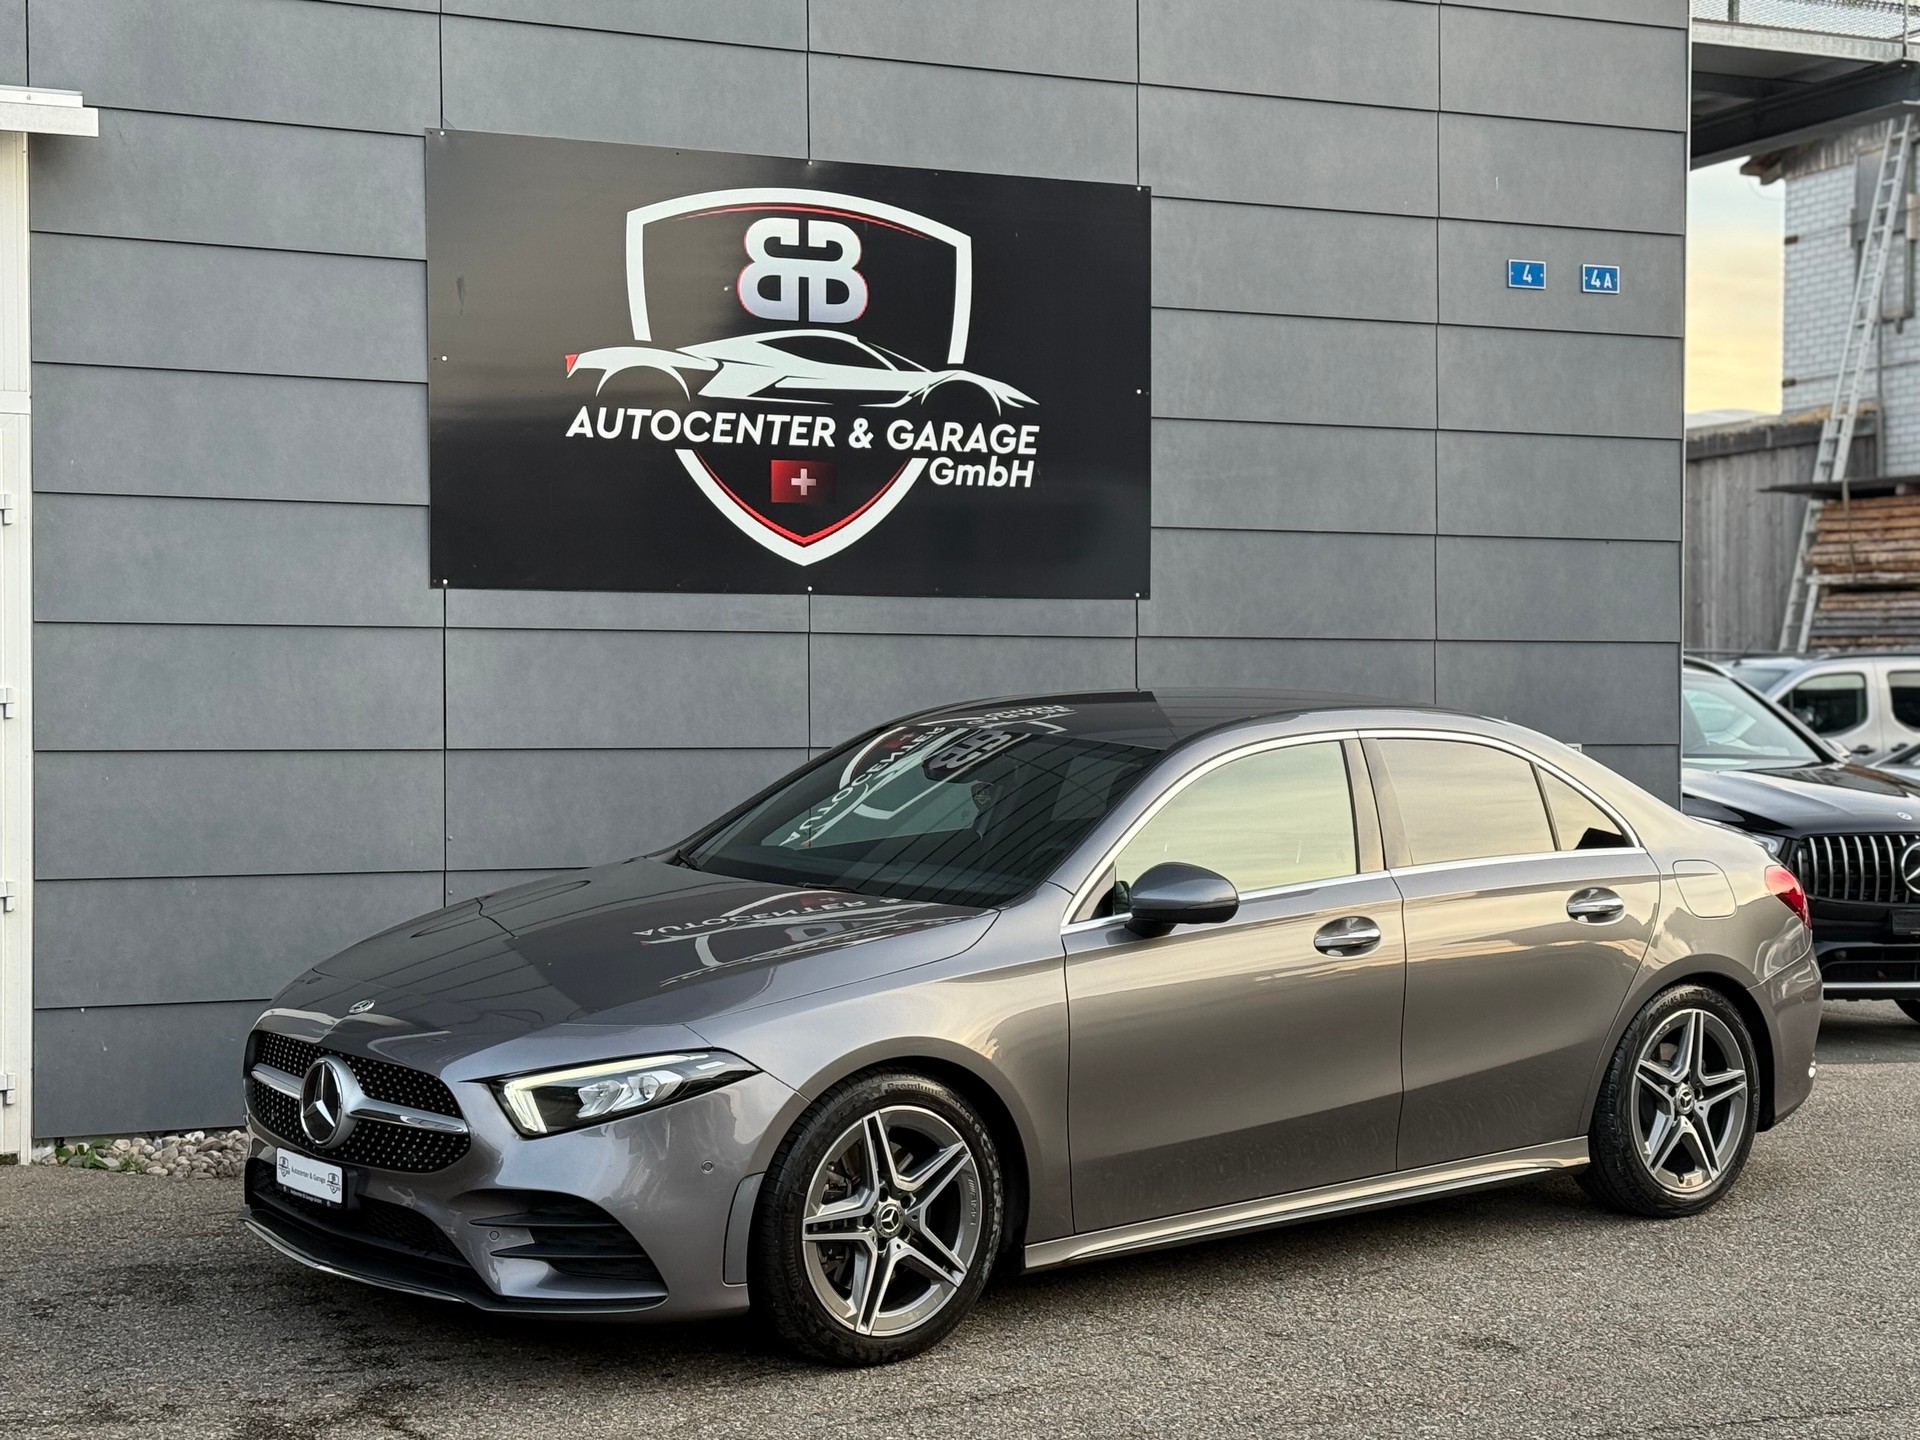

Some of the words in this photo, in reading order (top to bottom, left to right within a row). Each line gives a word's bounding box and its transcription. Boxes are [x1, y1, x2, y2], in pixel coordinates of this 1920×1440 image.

[1522, 264, 1533, 283] 4
[1590, 269, 1612, 289] 4A
[565, 405, 836, 448] AUTOCENTER
[847, 417, 875, 449] &
[886, 419, 1041, 455] GARAGE
[929, 456, 1035, 488] GmbH
